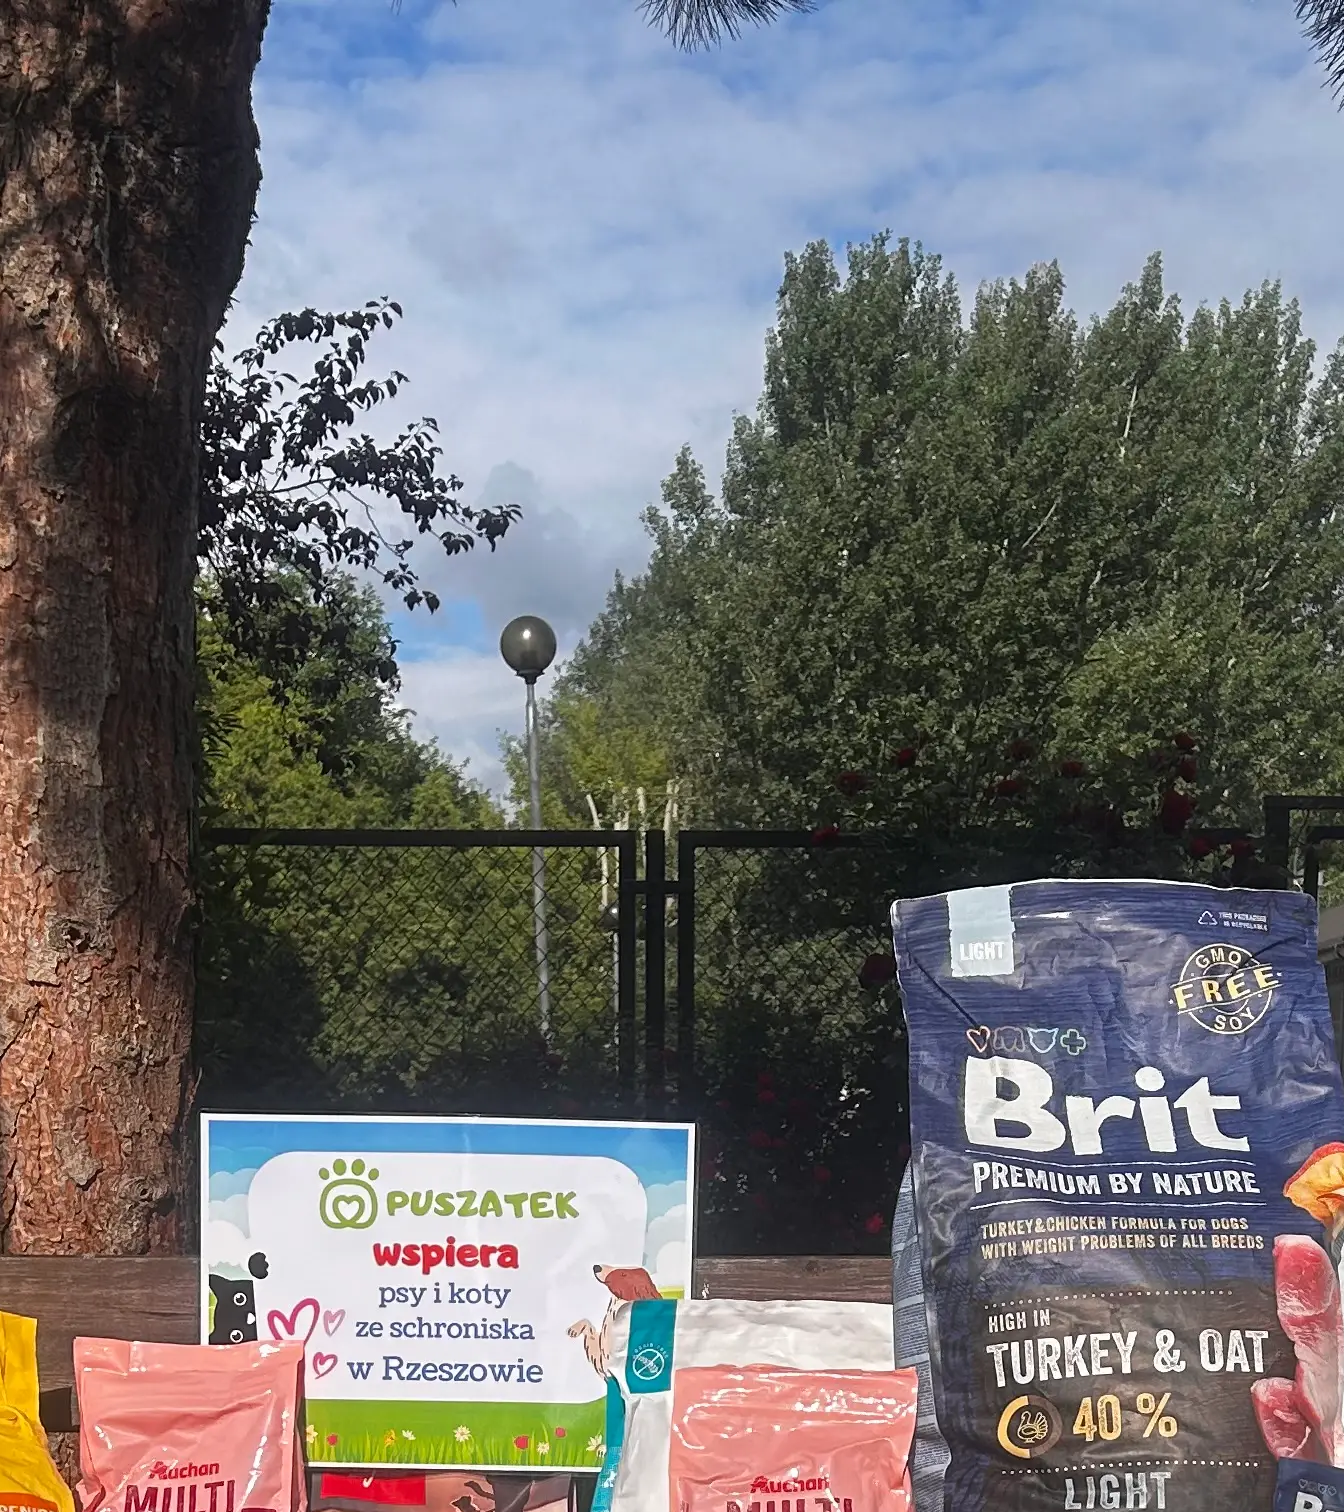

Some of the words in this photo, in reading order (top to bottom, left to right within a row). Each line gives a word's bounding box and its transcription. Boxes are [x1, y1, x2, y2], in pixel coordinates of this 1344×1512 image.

[959, 942, 1005, 961] LIGHT
[1195, 948, 1240, 967] GMO
[1173, 965, 1278, 1009] FREE
[1213, 1007, 1255, 1030] SOY
[964, 1055, 1250, 1156] Brit
[973, 1161, 1101, 1194] PREMIUM
[1109, 1173, 1141, 1193] BY
[1156, 1171, 1261, 1194] NATURE
[388, 1189, 579, 1219] PUSZATEK
[981, 1217, 1106, 1240] TURKEY&CHICKEN
[1112, 1217, 1176, 1231] FORMULA
[1181, 1219, 1207, 1231] FOR
[1211, 1218, 1248, 1231] DOGS
[374, 1237, 519, 1274] wspiera
[982, 1242, 1017, 1259] WITH
[1021, 1239, 1074, 1255] WEIGHT
[1081, 1236, 1155, 1250] PROBLEMS
[1160, 1236, 1177, 1247] OF
[1182, 1235, 1207, 1247] ALL
[1212, 1235, 1264, 1249] BREEDS
[379, 1285, 424, 1307] psy
[434, 1282, 442, 1303] i
[449, 1283, 511, 1307] koty
[356, 1321, 383, 1336] ze
[389, 1317, 535, 1340] schroniska
[988, 1312, 1026, 1333] HIGH
[1033, 1309, 1051, 1326] IN
[347, 1360, 374, 1380] w
[382, 1356, 543, 1383] Rzeszowie
[986, 1332, 1138, 1388] TURKEY
[1154, 1329, 1186, 1373] &
[1200, 1329, 1269, 1373] OAT
[1072, 1394, 1121, 1441] 40
[1136, 1392, 1178, 1438] %
[149, 1461, 219, 1480] Auchan
[750, 1476, 828, 1493] Auchan
[1065, 1472, 1171, 1510] LIGHT
